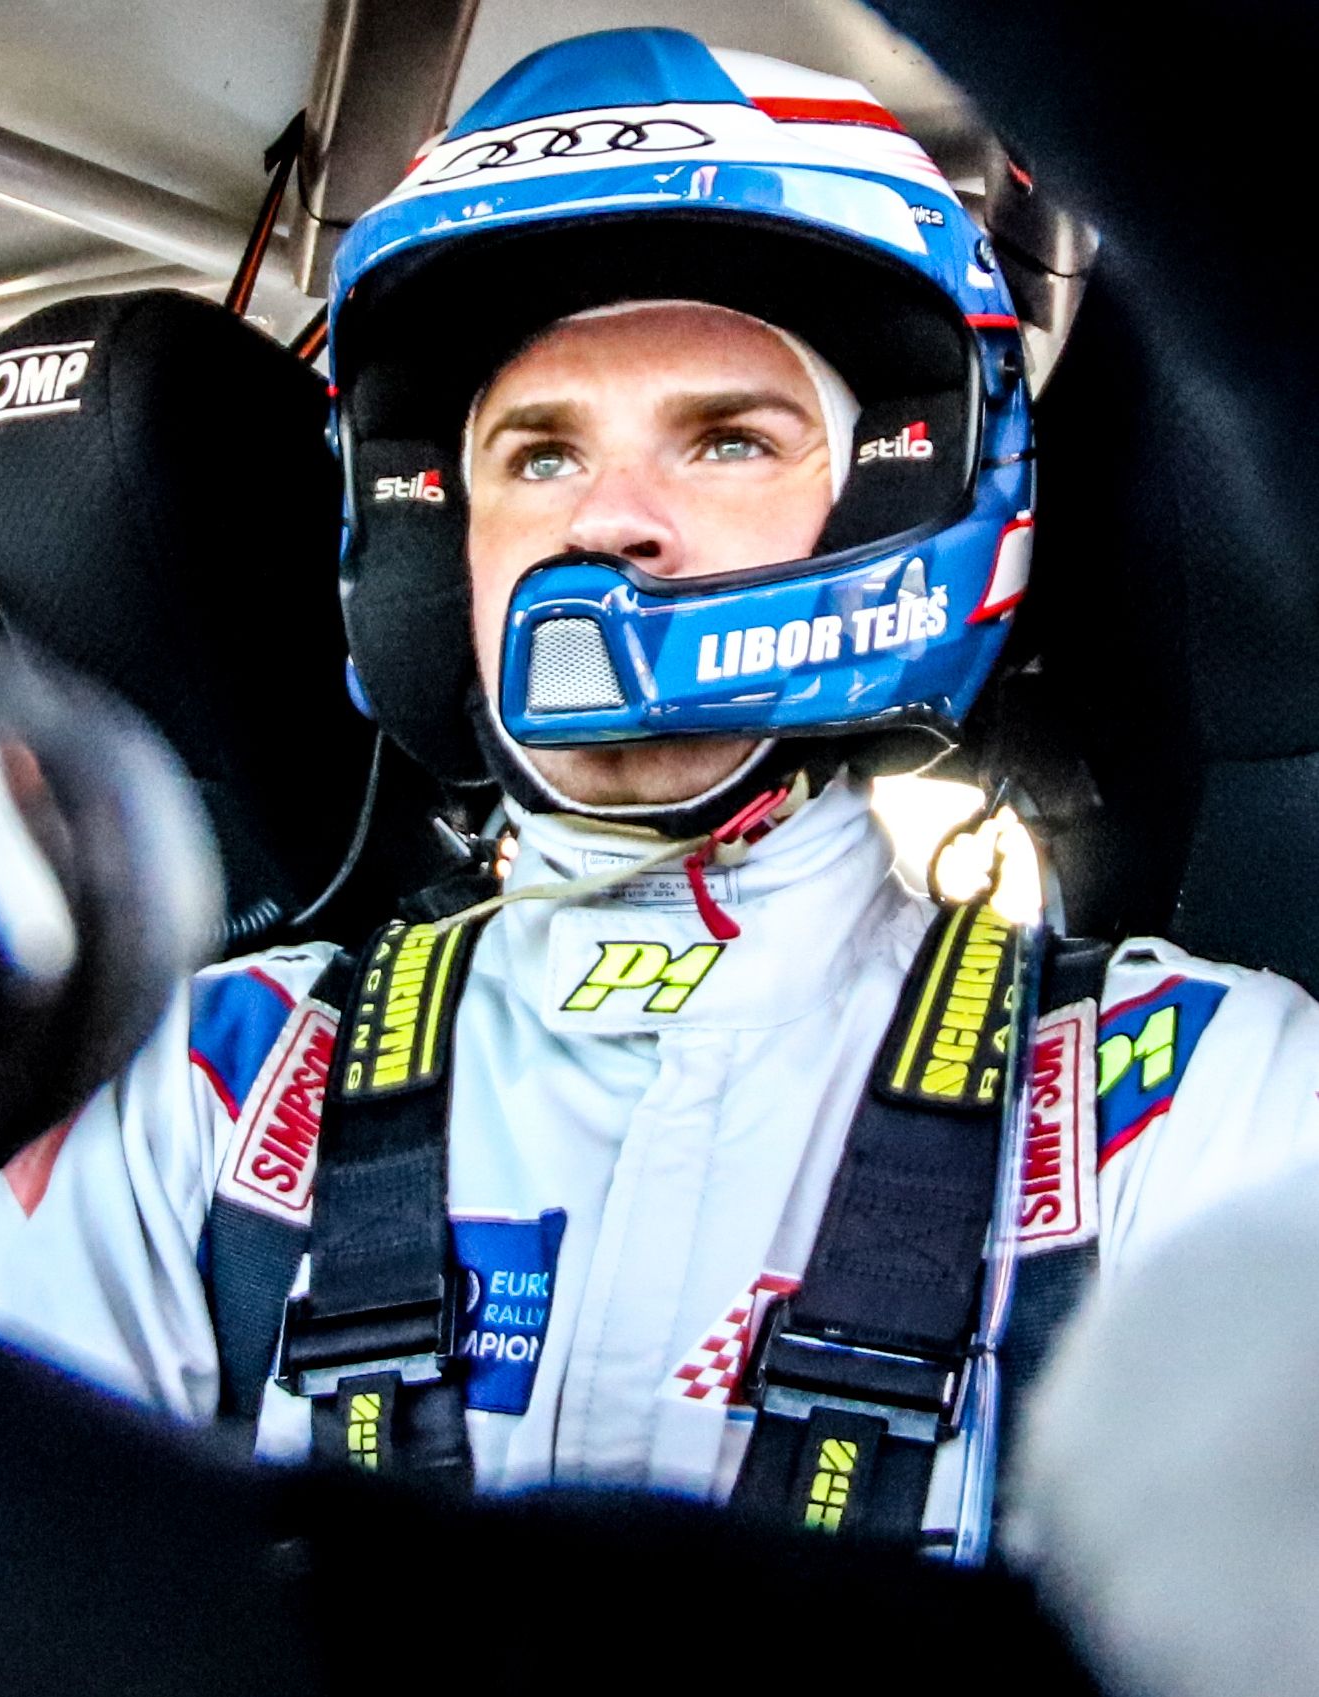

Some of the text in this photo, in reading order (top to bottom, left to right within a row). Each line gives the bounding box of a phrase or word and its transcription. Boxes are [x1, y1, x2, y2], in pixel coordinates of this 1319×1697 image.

[857, 422, 934, 465] stilo
[374, 470, 446, 502] stilo
[696, 614, 843, 683] LIBOR
[559, 940, 728, 1013] P1
[251, 1025, 338, 1193] SIMPSON
[1016, 1035, 1064, 1229] SIMPSON
[482, 1302, 546, 1327] RALLY
